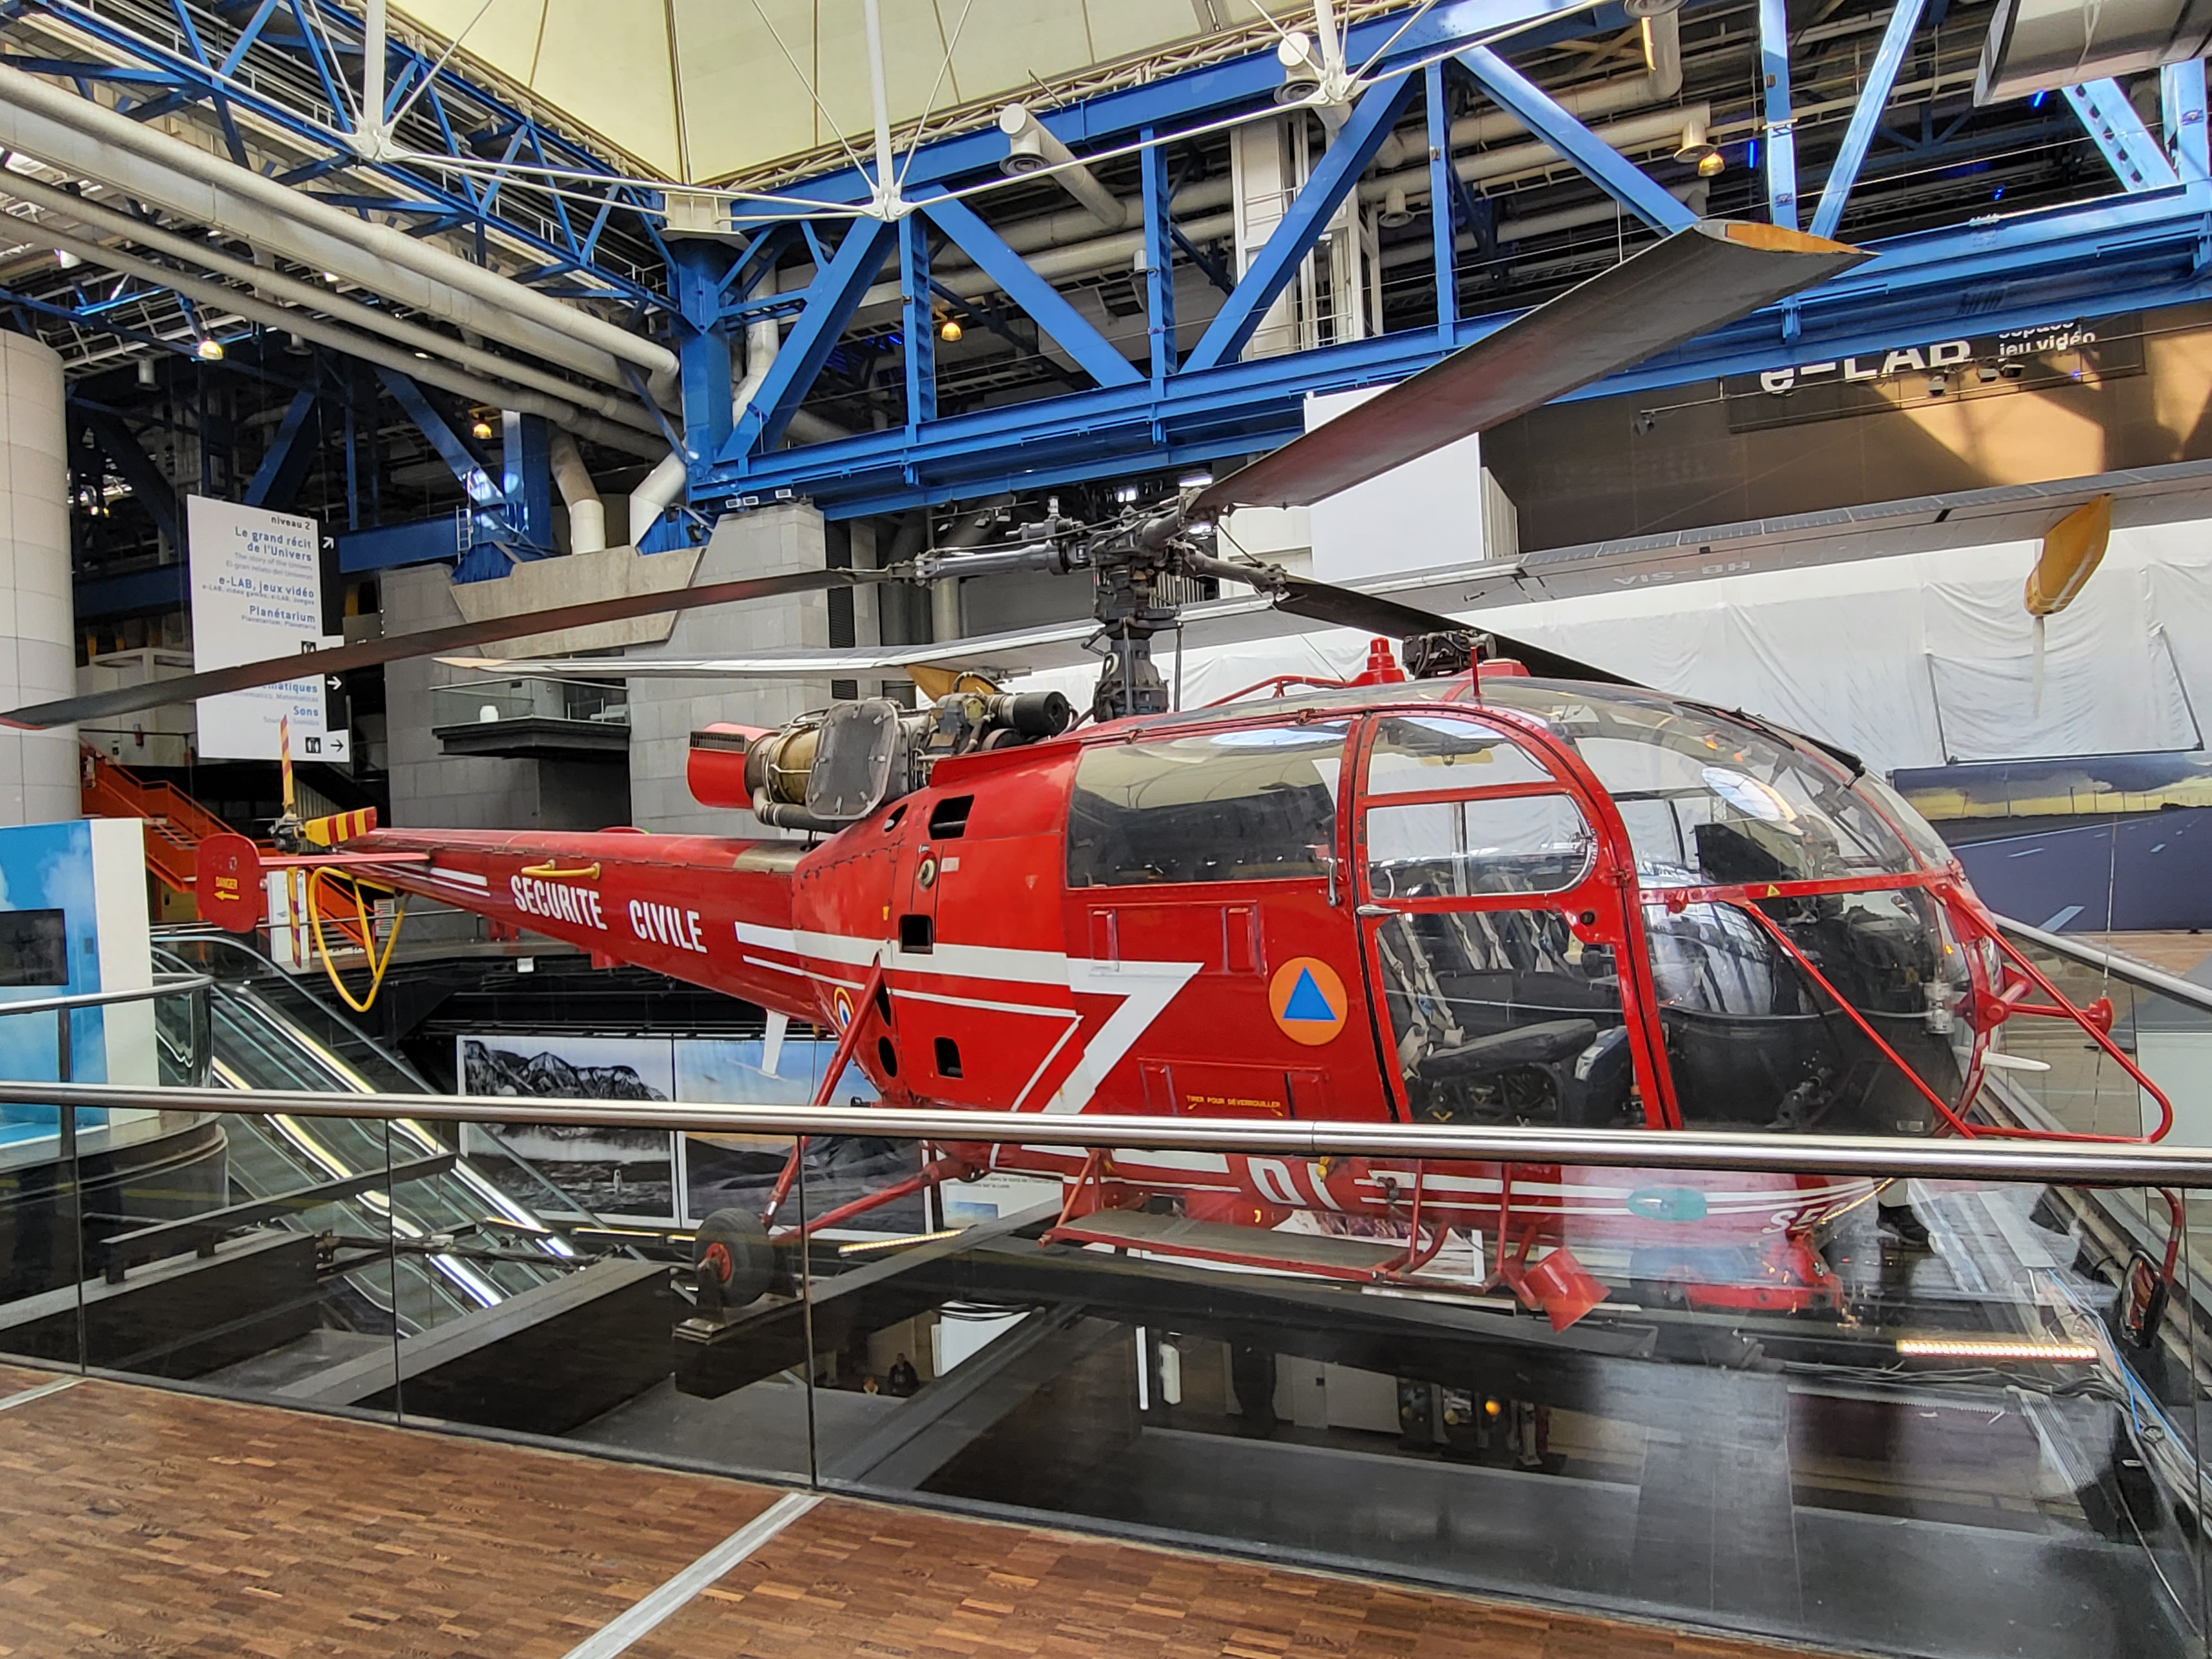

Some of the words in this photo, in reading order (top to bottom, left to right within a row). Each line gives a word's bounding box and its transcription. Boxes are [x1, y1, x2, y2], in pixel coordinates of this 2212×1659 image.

[271, 517, 302, 528] niveau
[305, 521, 310, 530] 2
[235, 526, 248, 537] Le
[252, 531, 283, 543] grand
[286, 536, 311, 549] récit
[247, 542, 260, 552] de
[264, 545, 311, 561] l'Univers
[219, 576, 255, 591] e-LAB,
[259, 580, 283, 593] jeux
[285, 586, 314, 598] vidéo
[249, 605, 316, 623] Planétarium
[293, 706, 319, 717] Sons
[510, 875, 608, 930] SECURITE
[629, 899, 708, 953] CIVILE
